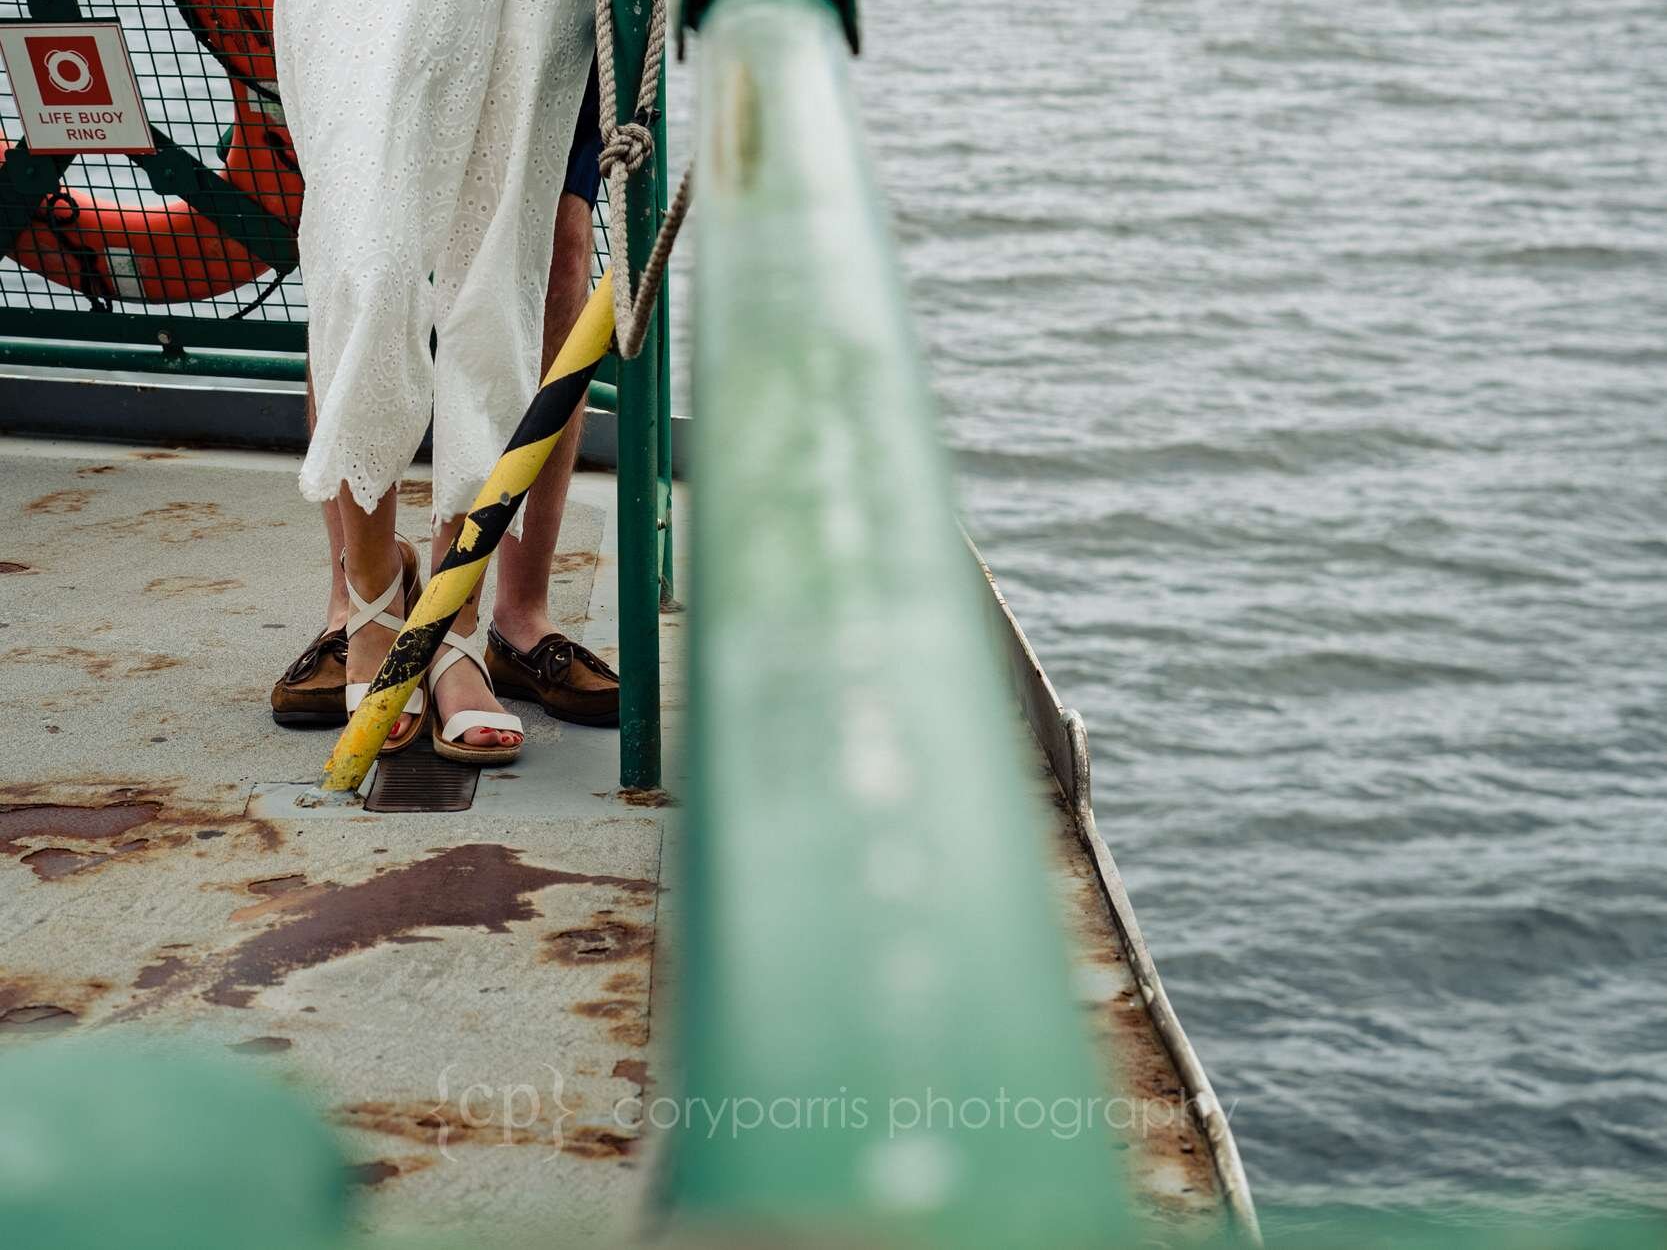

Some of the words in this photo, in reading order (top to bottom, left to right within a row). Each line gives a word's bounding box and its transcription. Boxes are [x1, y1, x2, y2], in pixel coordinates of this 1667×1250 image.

[38, 112, 75, 124] LIFE
[78, 112, 124, 124] BUOY
[66, 129, 107, 141] RING
